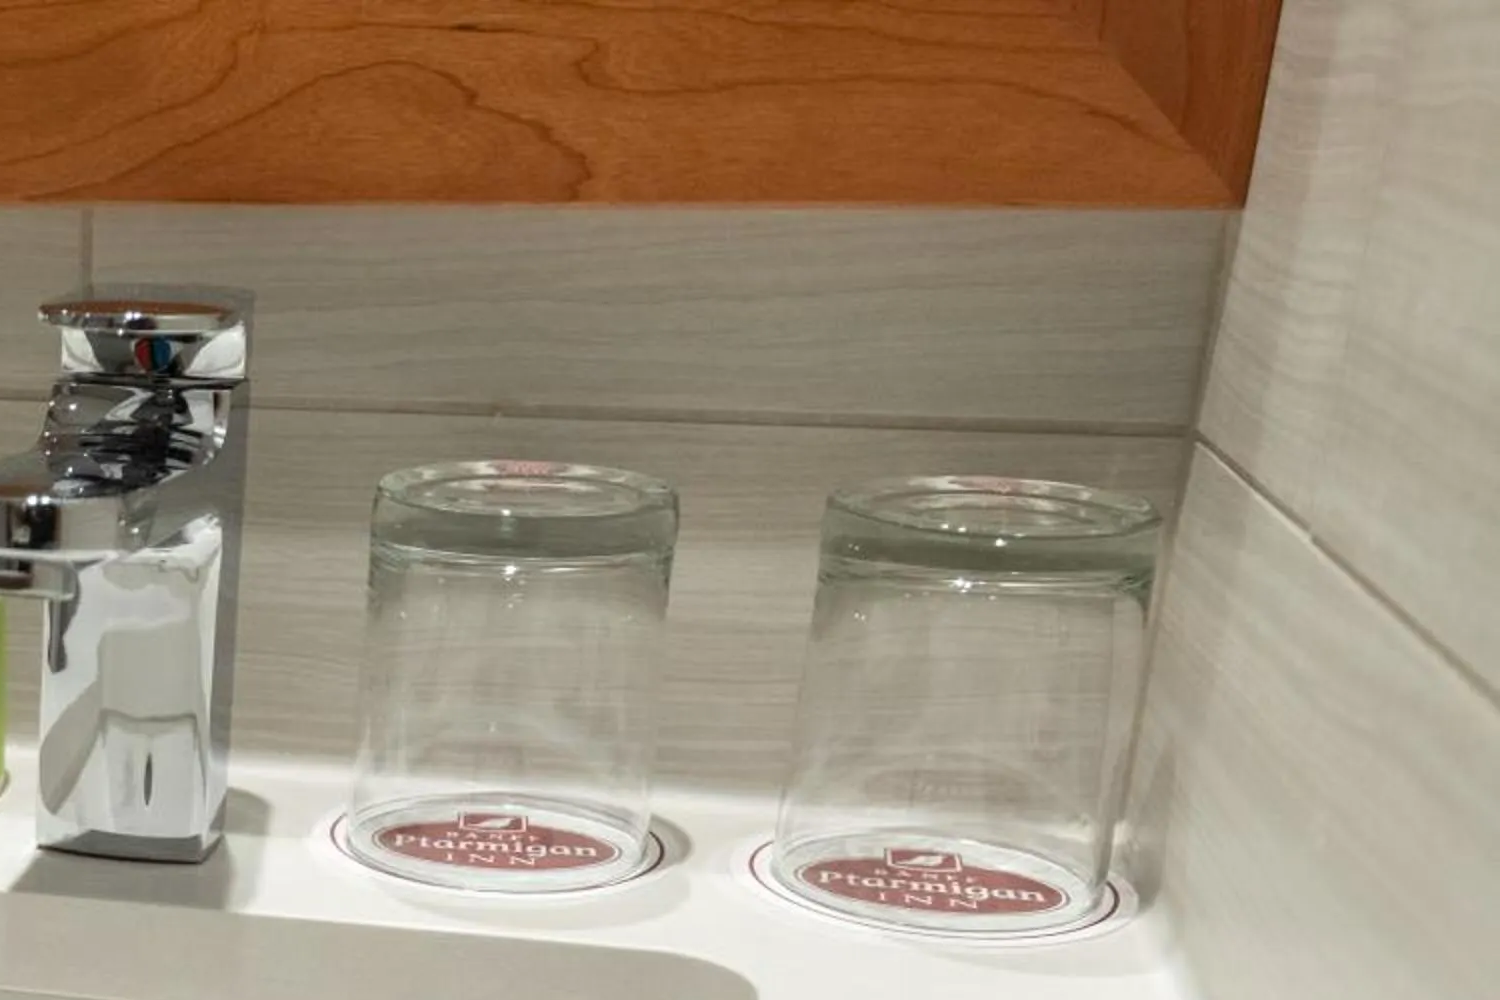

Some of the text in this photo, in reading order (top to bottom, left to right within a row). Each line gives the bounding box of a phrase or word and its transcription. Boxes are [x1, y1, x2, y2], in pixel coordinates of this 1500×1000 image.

[394, 833, 598, 858] Ptarmigan
[445, 852, 537, 866] INN
[817, 871, 1046, 902] Ptarmigan
[879, 892, 978, 910] INN
